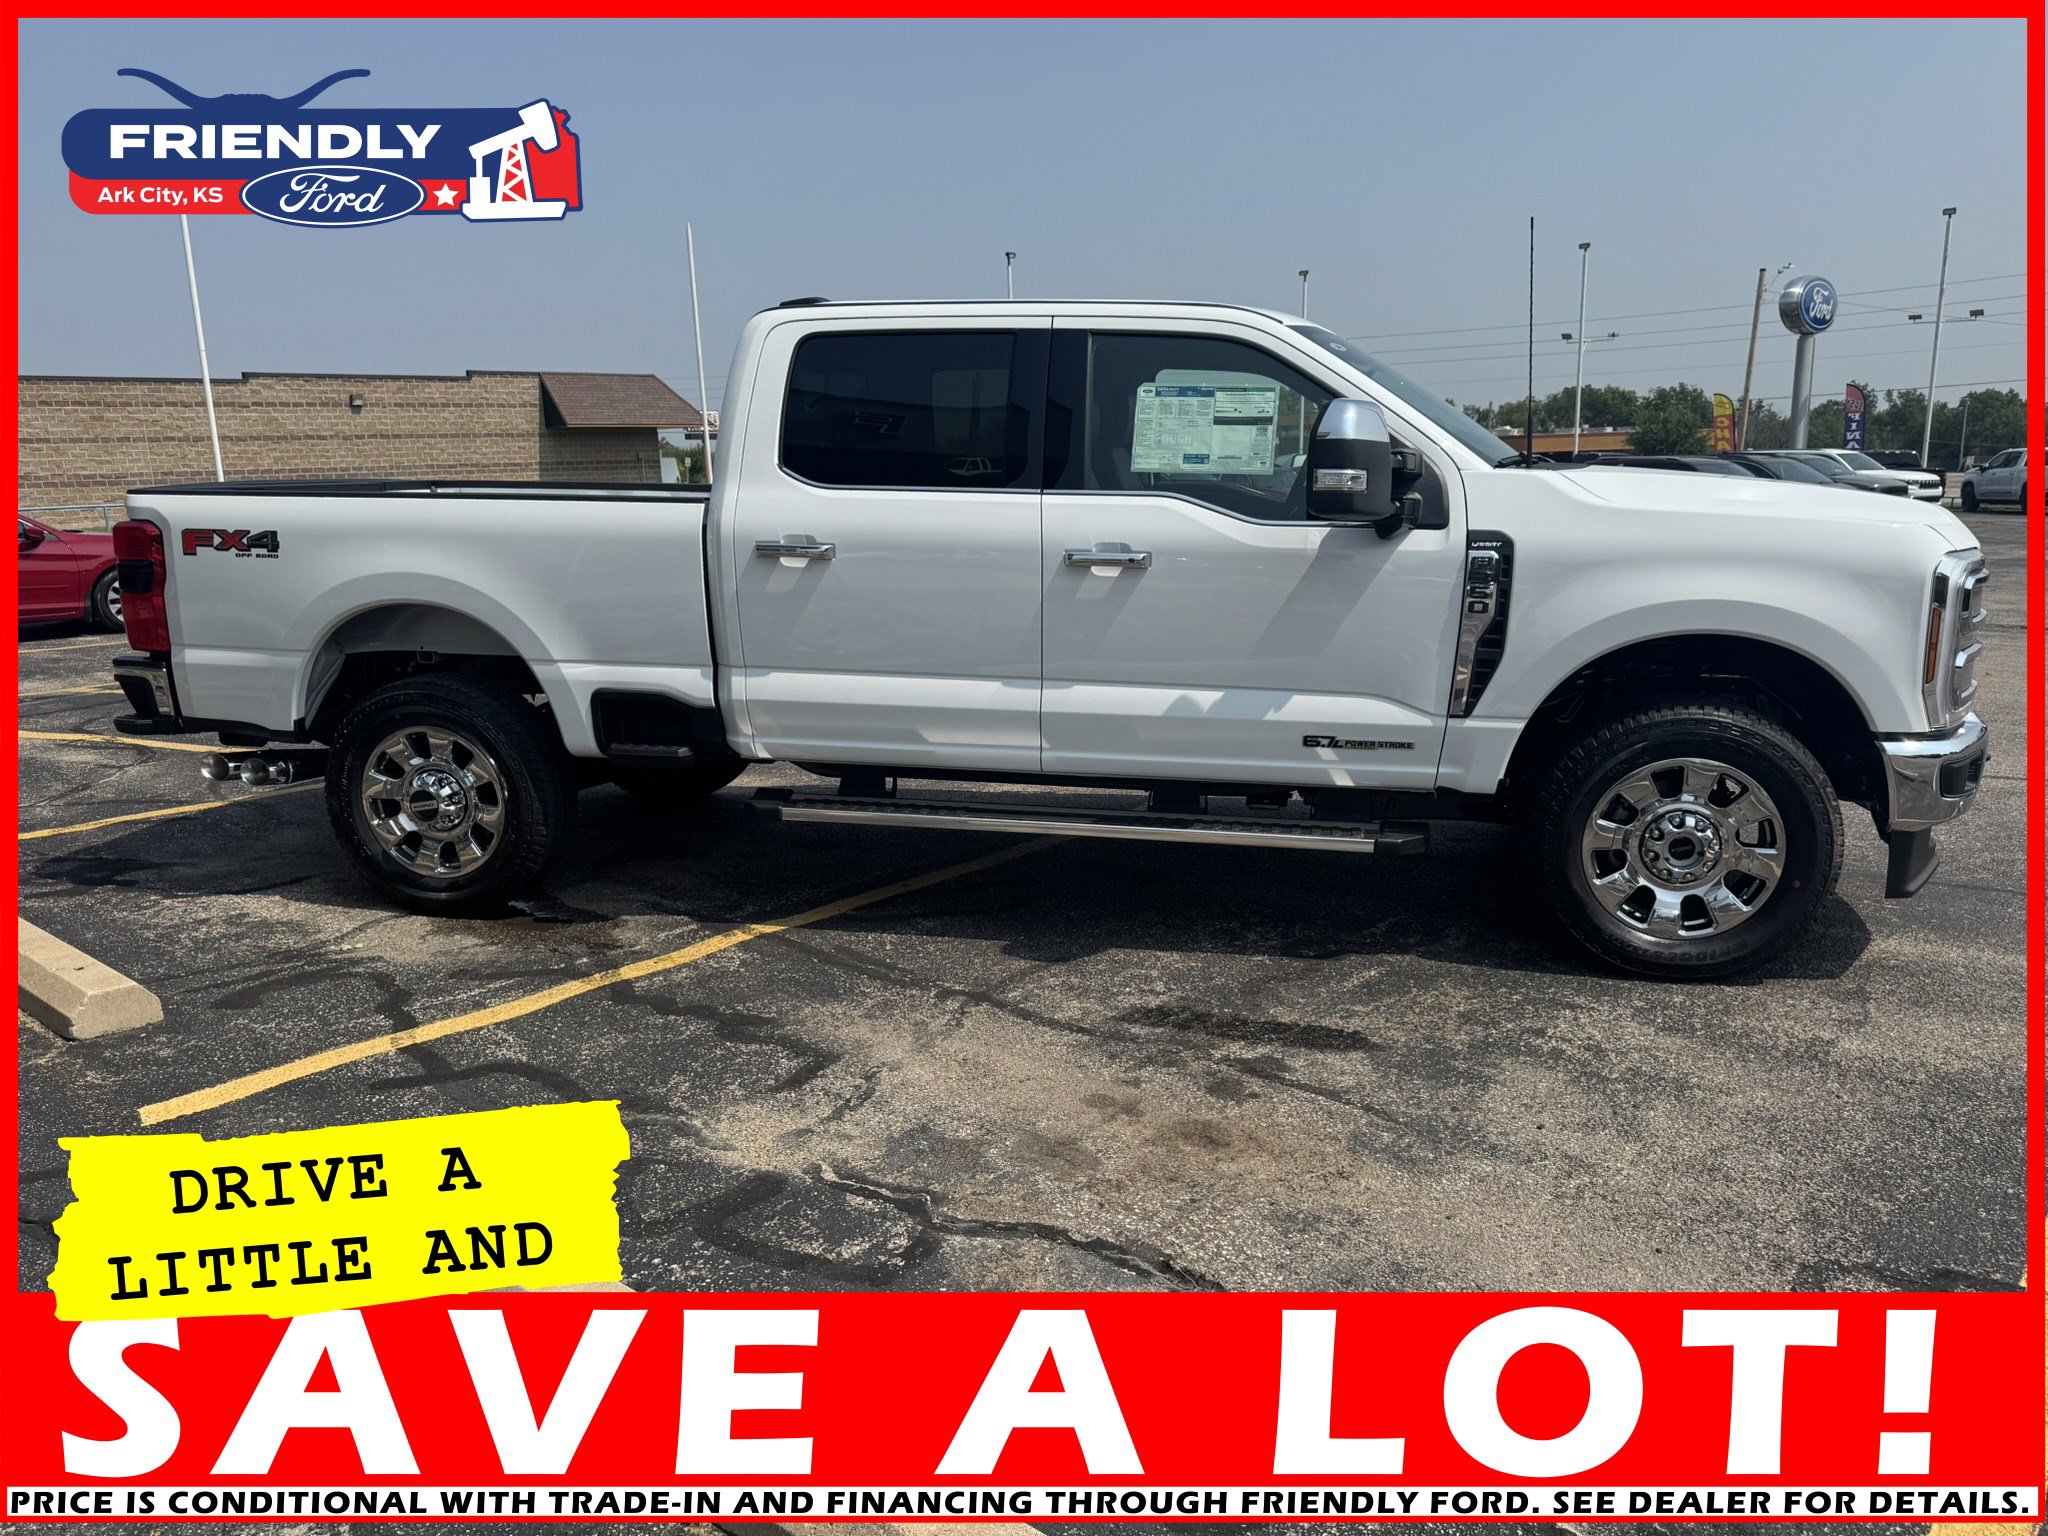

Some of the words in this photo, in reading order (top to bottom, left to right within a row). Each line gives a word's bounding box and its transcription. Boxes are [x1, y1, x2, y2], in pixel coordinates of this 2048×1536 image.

[1809, 287, 1834, 320] Ford
[181, 528, 280, 556] FX4
[1302, 735, 1344, 748] 6.7L
[1344, 739, 1376, 748] POWER
[1377, 740, 1413, 749] STROKE
